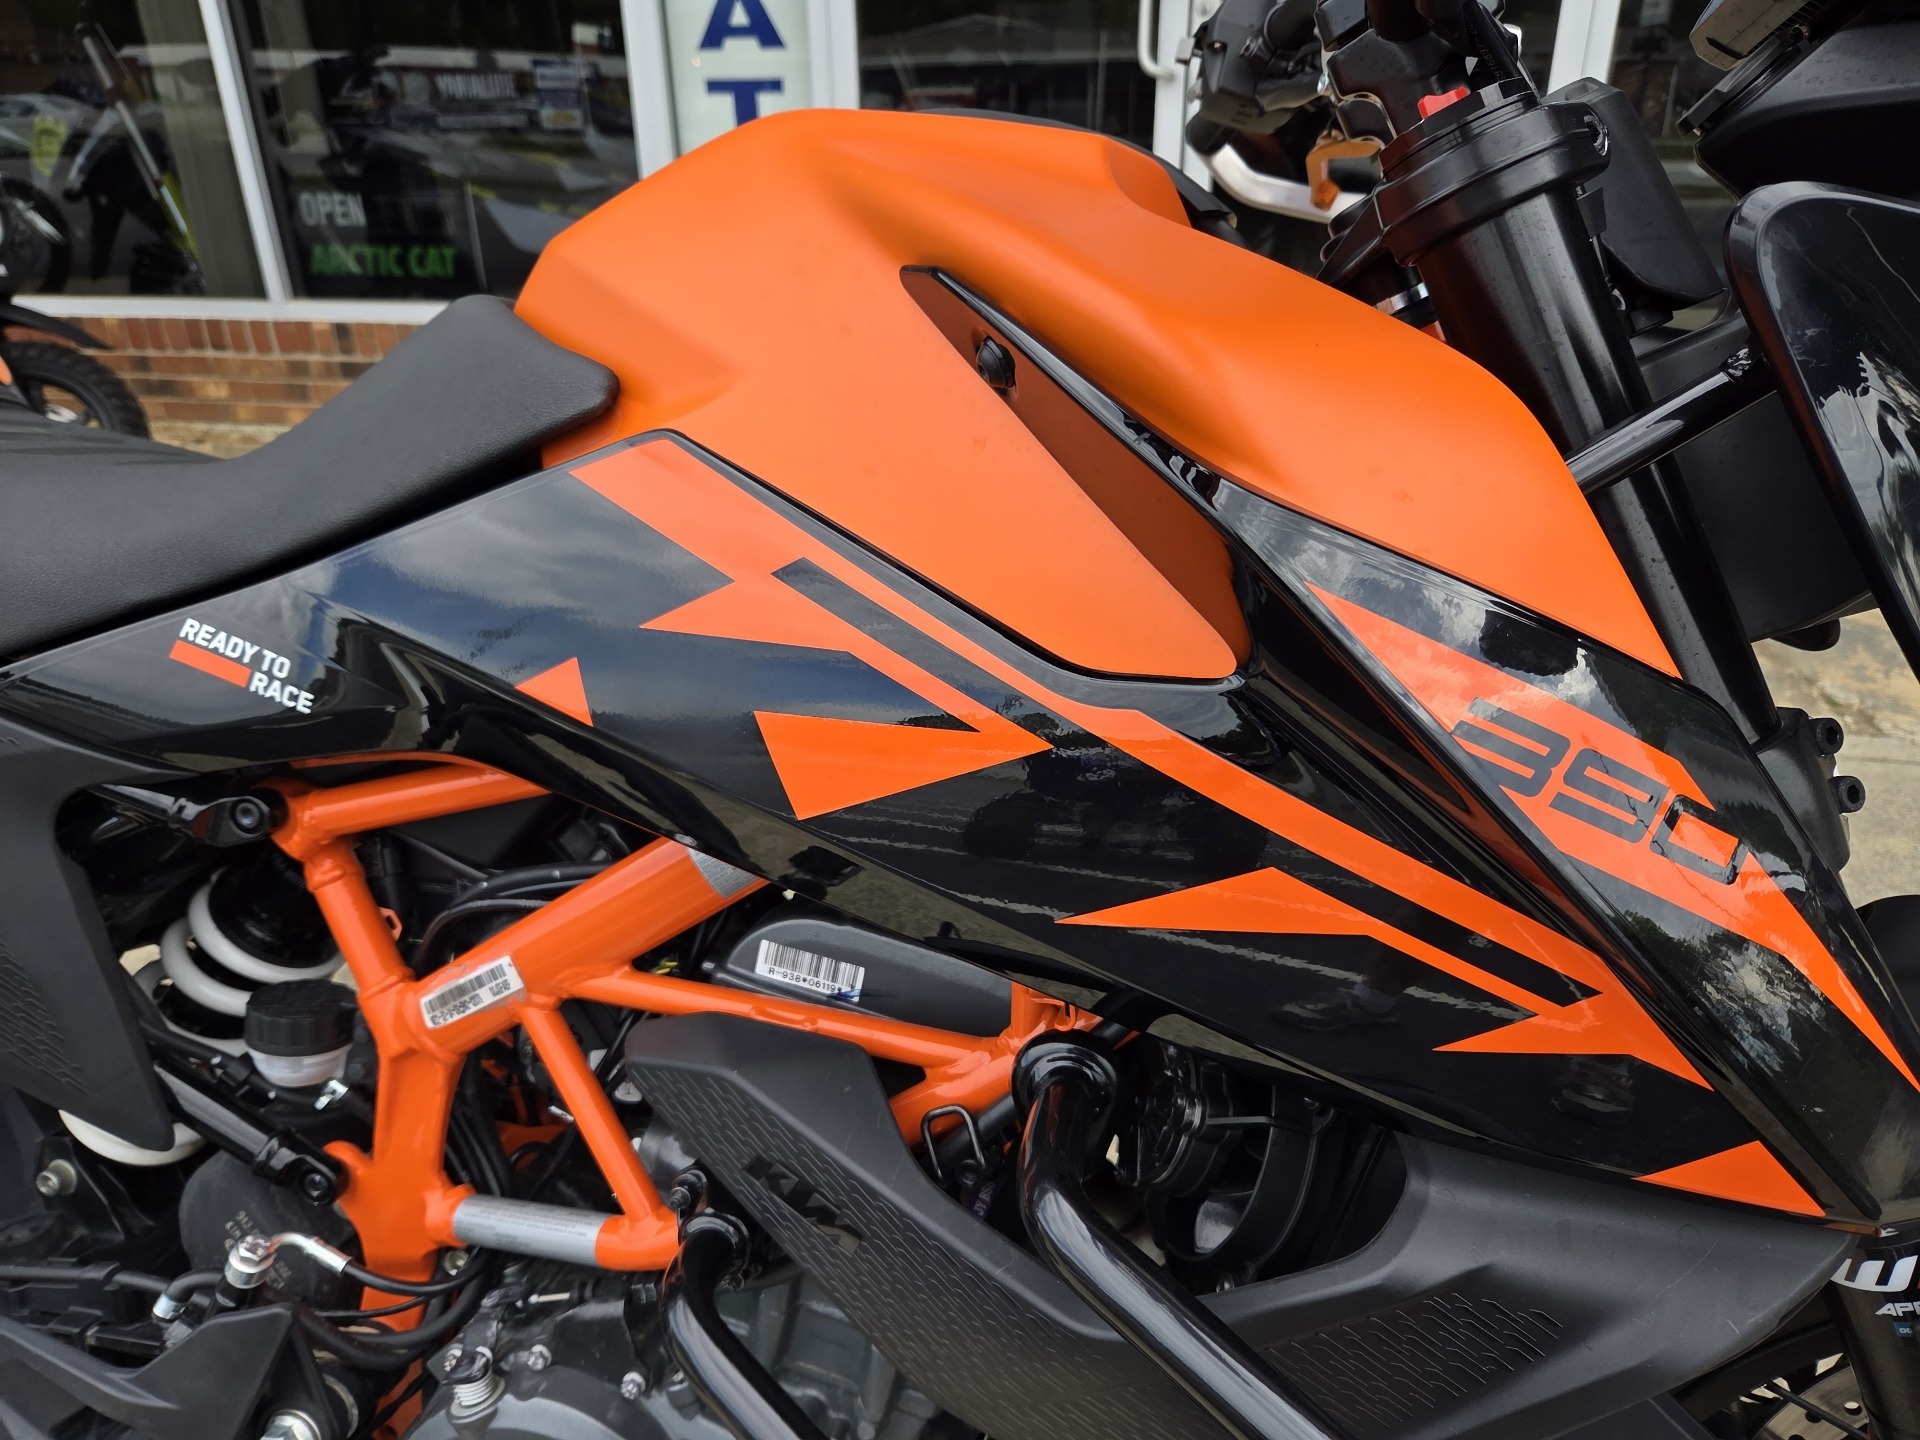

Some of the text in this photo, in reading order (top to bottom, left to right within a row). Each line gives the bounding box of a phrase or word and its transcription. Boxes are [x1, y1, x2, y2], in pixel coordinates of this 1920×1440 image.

[299, 191, 367, 227] OPEN
[310, 243, 458, 278] ARCTIC CAT
[179, 618, 291, 679] READY TO
[249, 671, 315, 715] RACE
[1450, 697, 1749, 885] 390
[742, 1154, 864, 1255] KTM
